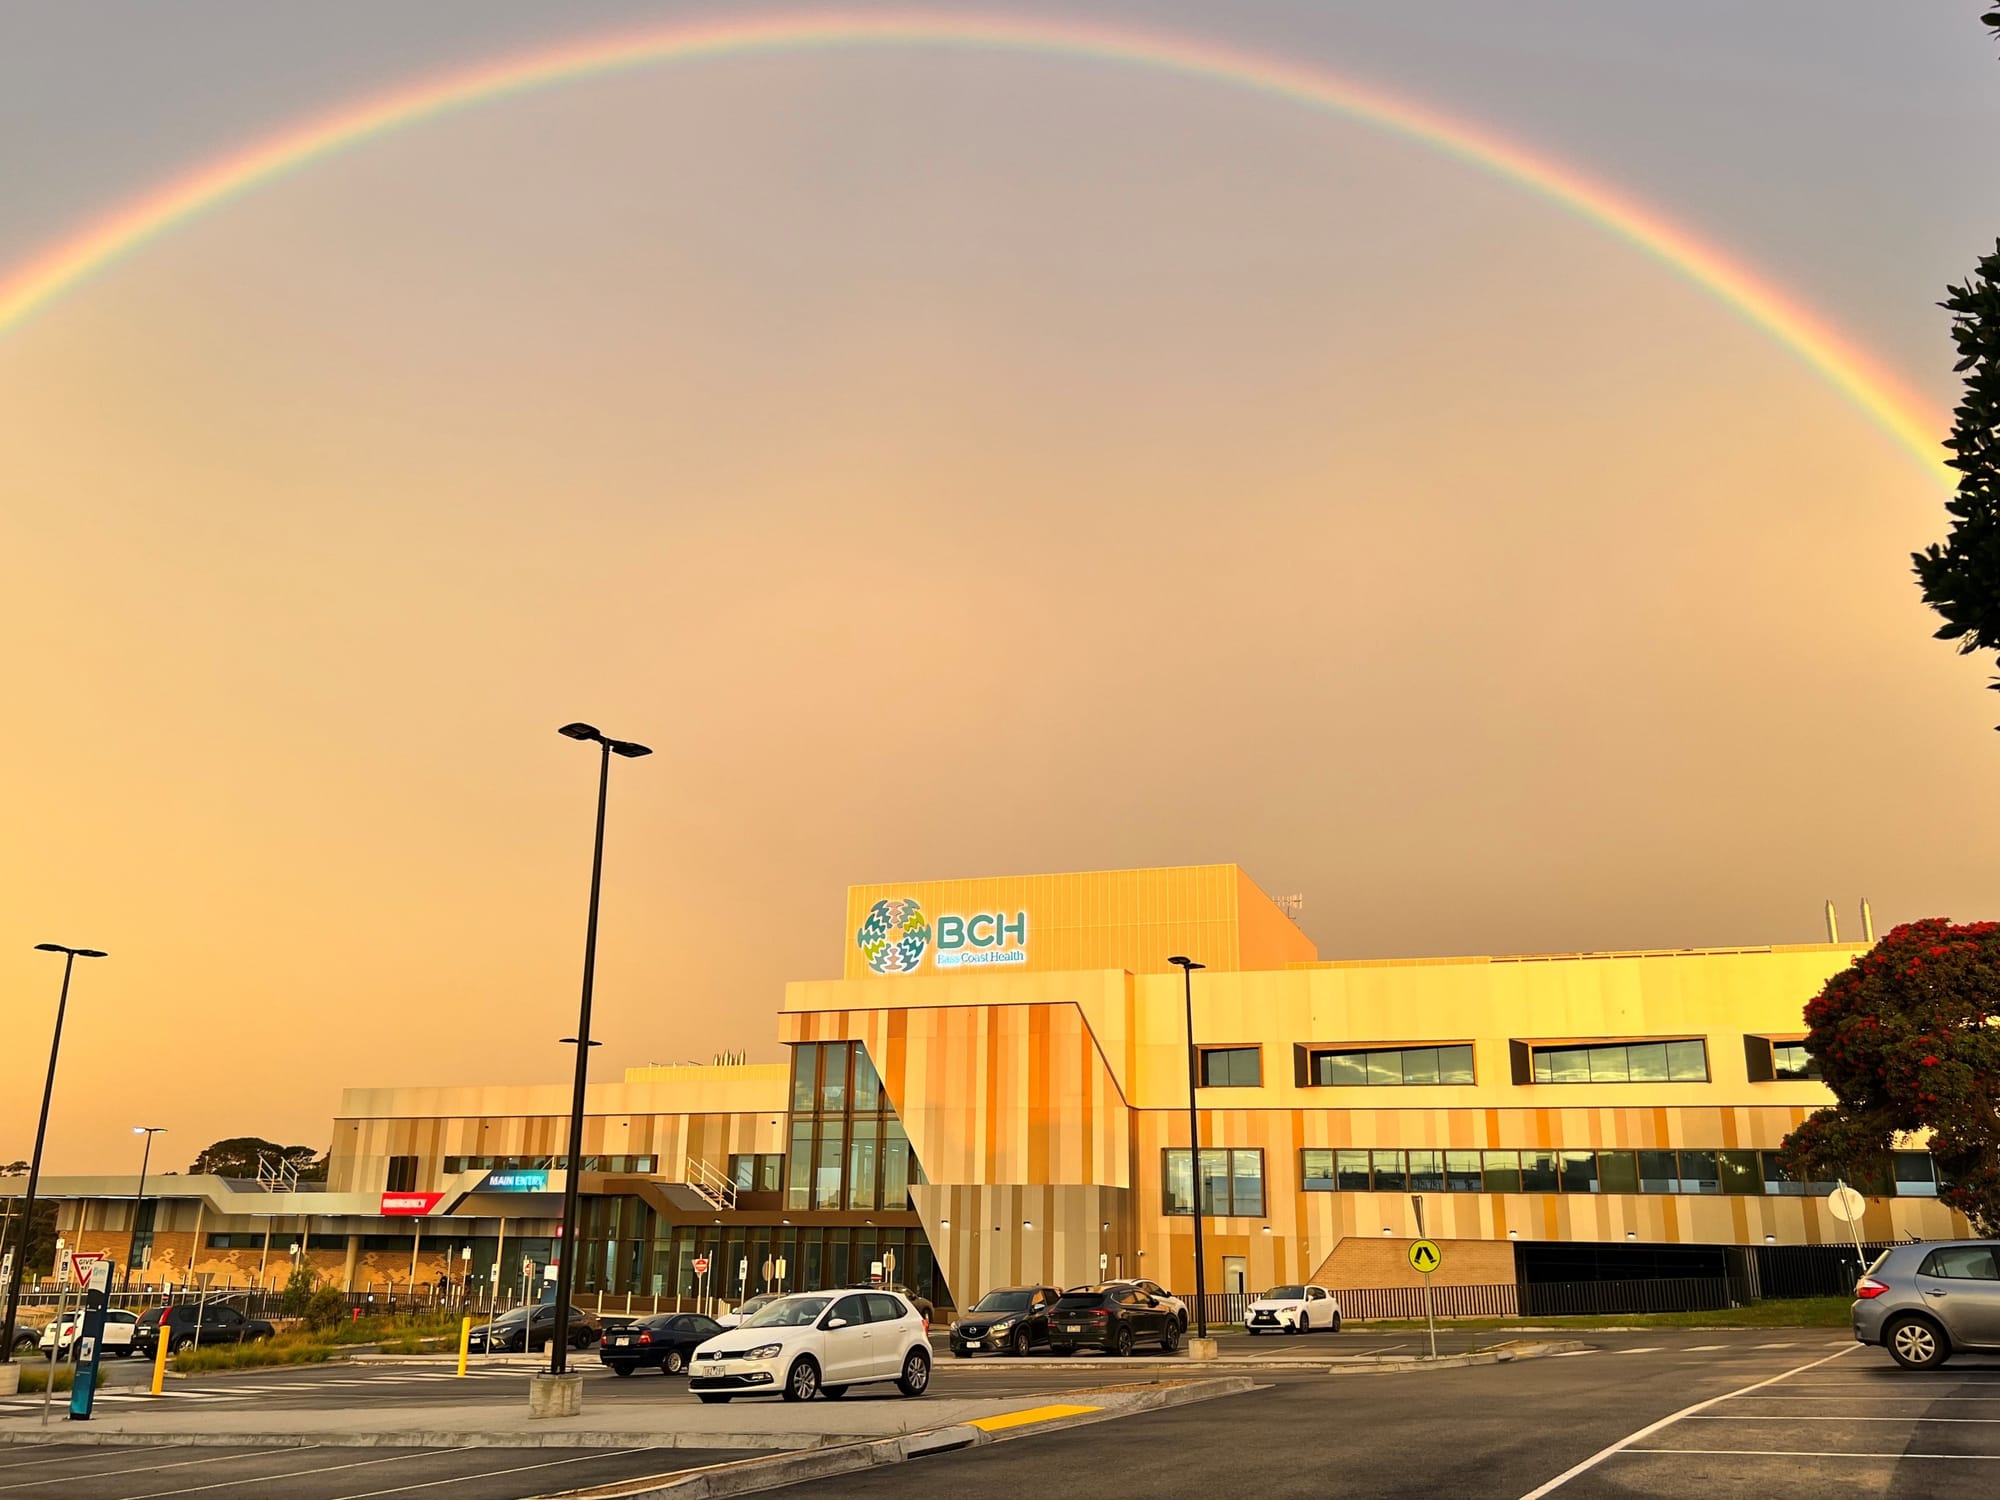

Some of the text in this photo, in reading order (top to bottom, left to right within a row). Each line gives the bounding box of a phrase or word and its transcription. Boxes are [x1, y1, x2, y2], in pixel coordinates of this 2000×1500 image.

[937, 911, 1025, 949] BCH
[961, 952, 989, 963] Coast
[990, 950, 1024, 962] Health
[489, 1175, 545, 1186] MAIN ENTRY
